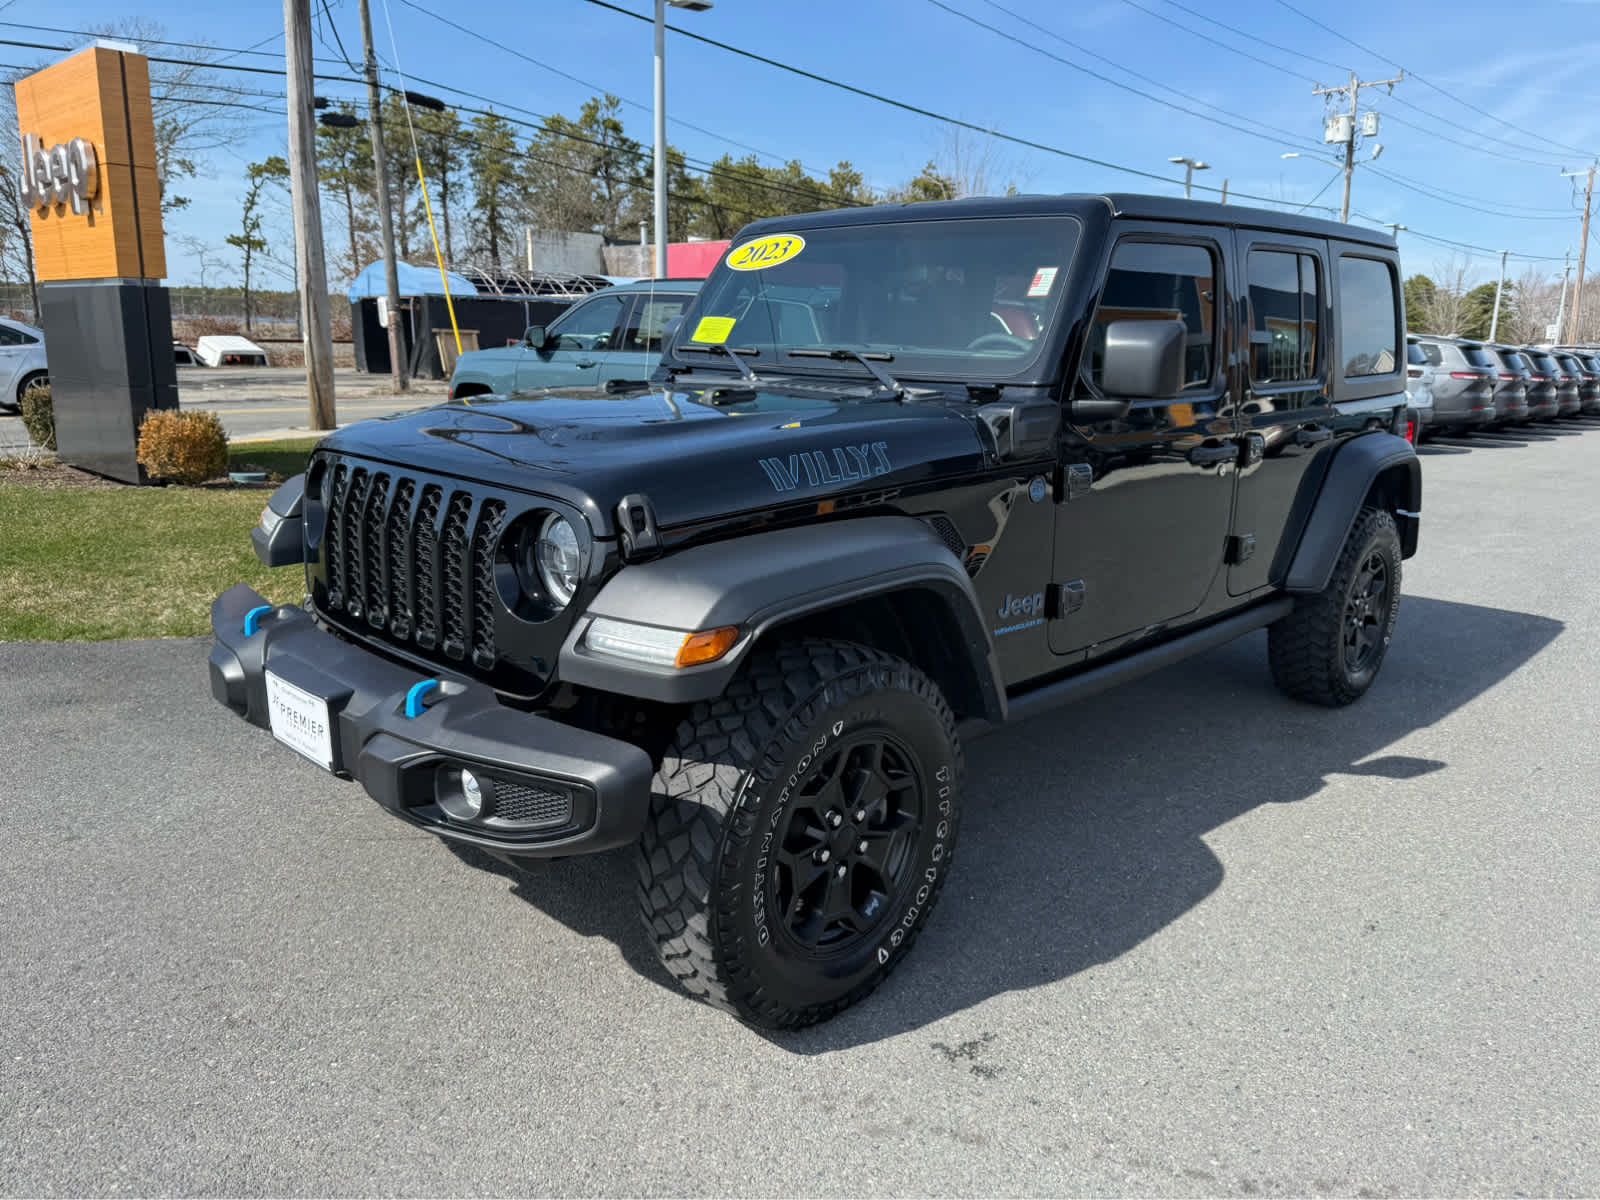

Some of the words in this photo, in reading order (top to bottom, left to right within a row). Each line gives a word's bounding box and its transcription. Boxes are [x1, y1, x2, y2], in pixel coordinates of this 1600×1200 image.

[20, 133, 97, 215] Jeep
[736, 240, 793, 265] 2023
[758, 441, 892, 492] WILLYS
[997, 592, 1044, 618] Jeep
[280, 703, 324, 735] PREMIER
[753, 736, 827, 945] DESTINATION
